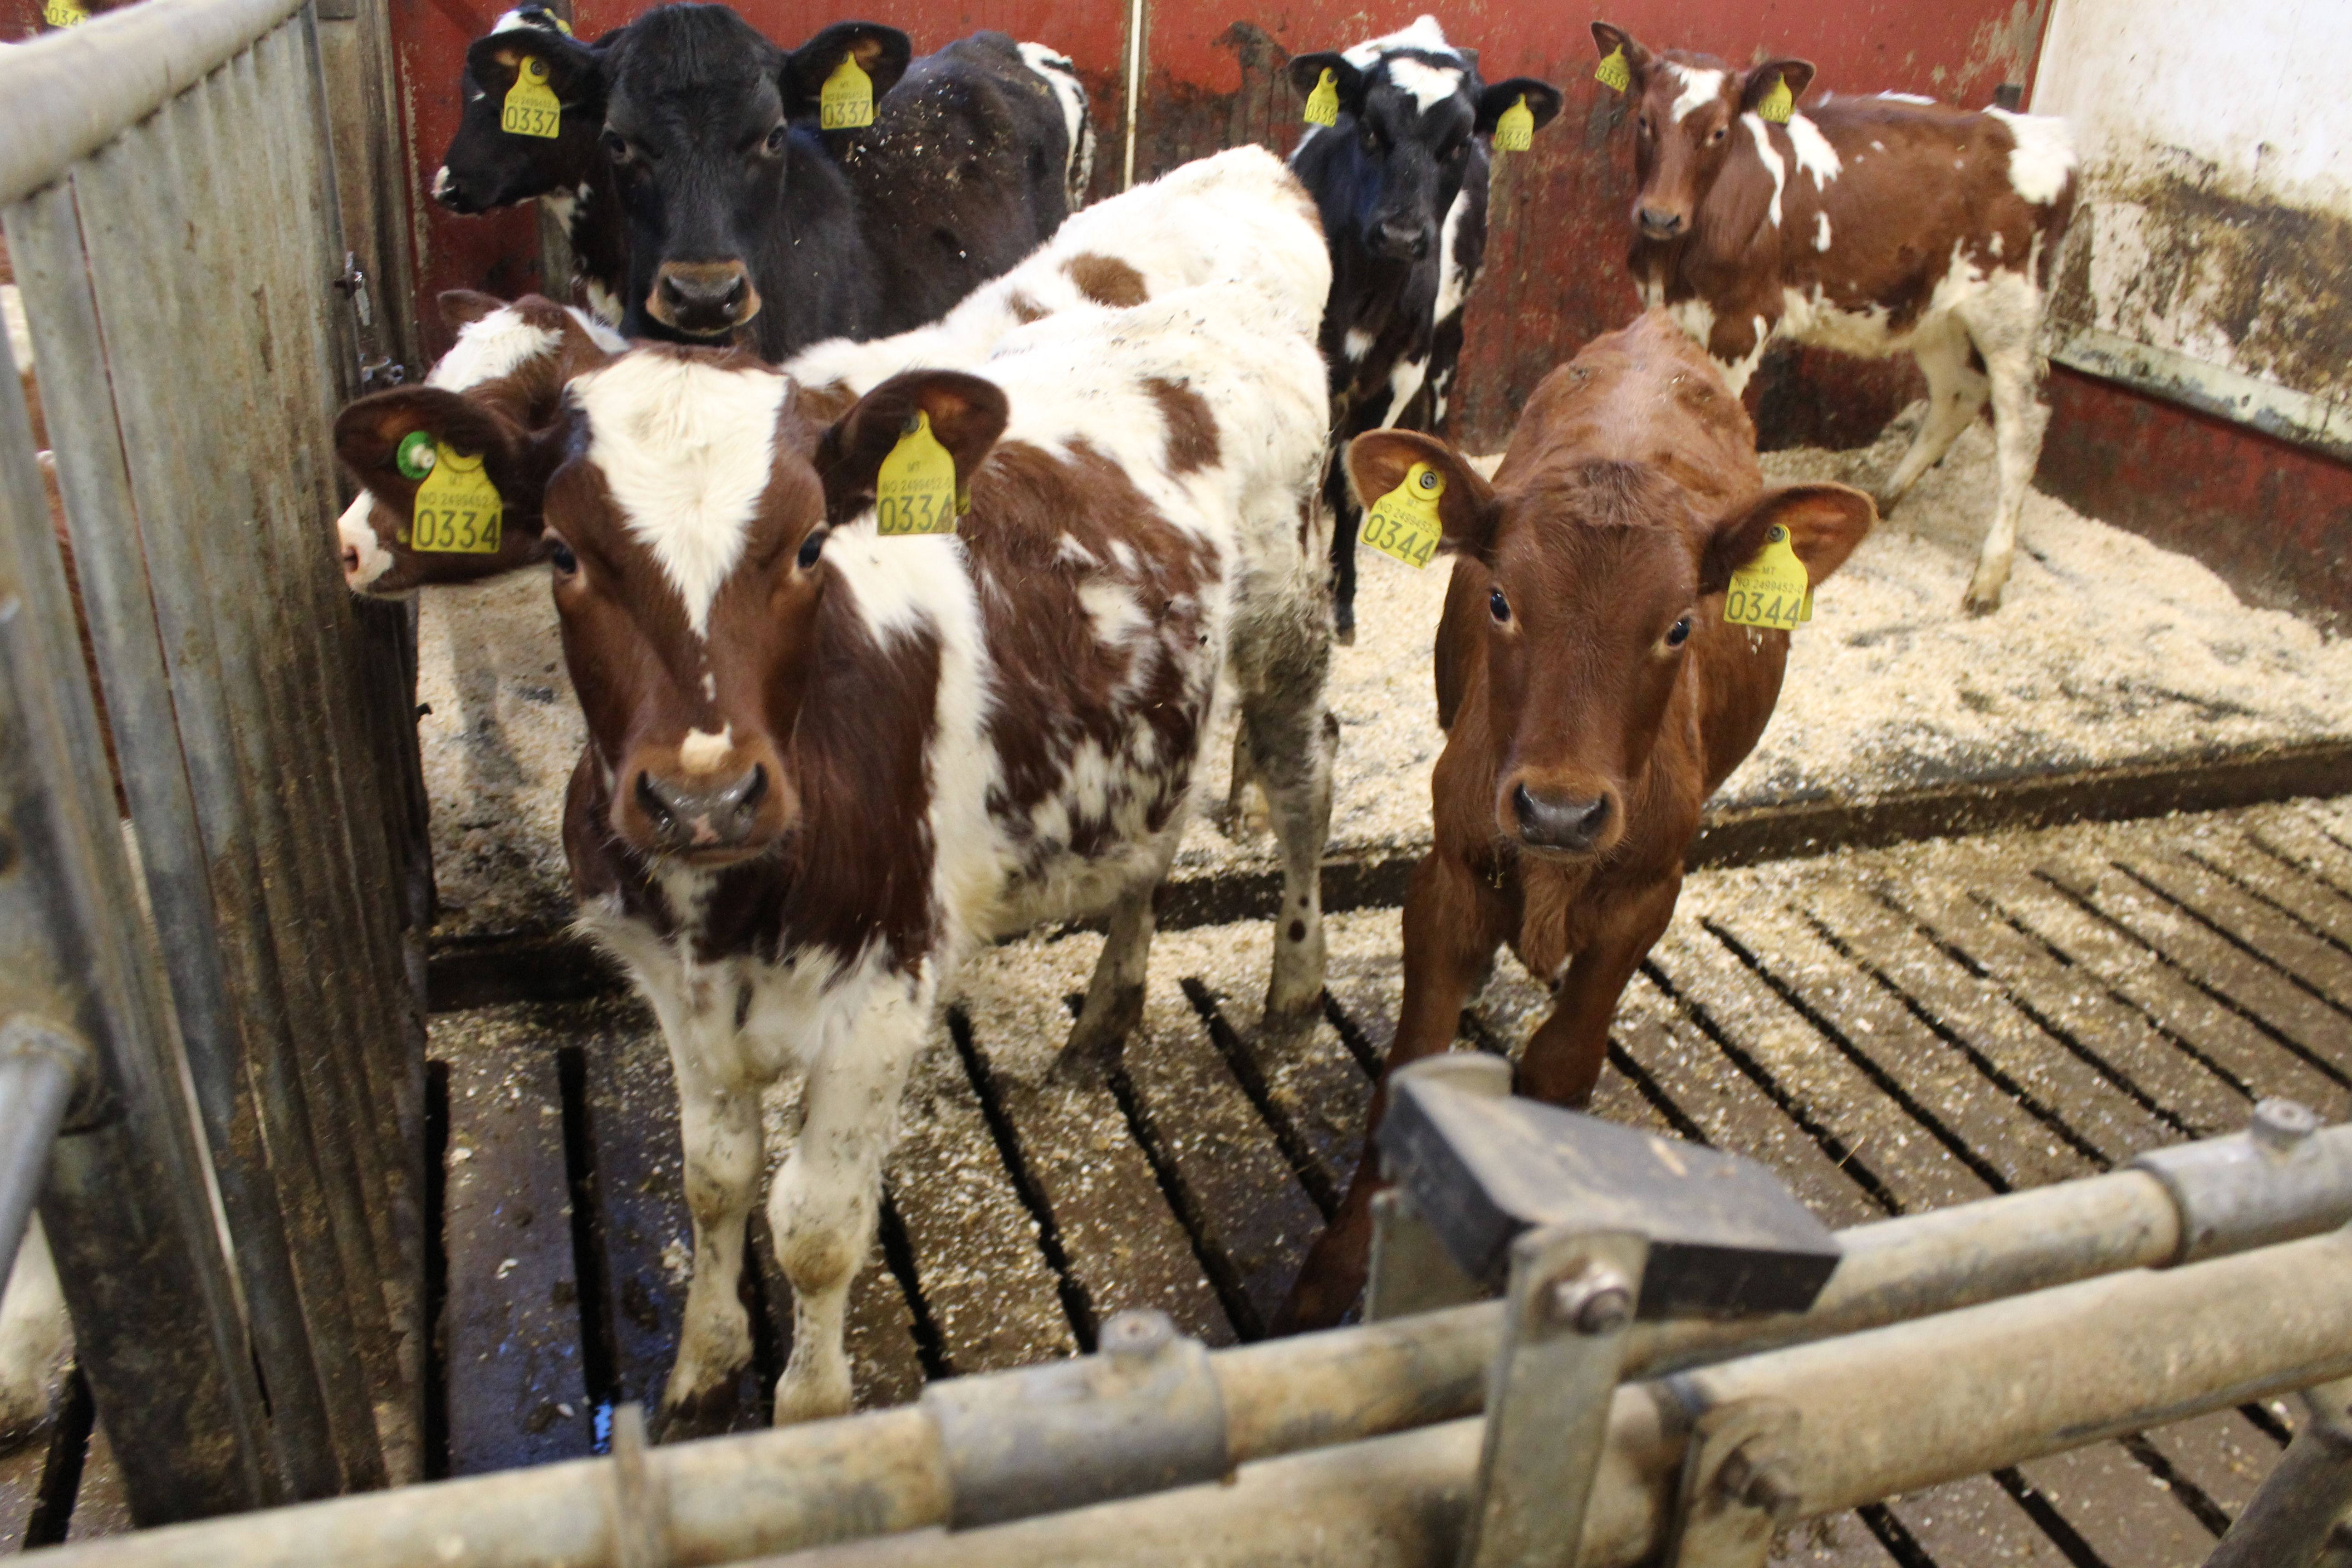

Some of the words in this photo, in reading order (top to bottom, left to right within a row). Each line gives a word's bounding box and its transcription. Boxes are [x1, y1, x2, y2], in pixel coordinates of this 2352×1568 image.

[1597, 65, 1627, 87] 0339
[505, 106, 559, 135] 0337
[823, 100, 870, 126] 0337
[1307, 103, 1336, 123] 0338
[1496, 130, 1530, 147] 0338
[879, 492, 953, 533] 0334
[416, 509, 498, 550] 0334
[1364, 514, 1434, 567] 0344
[1762, 566, 1776, 575] MT
[1727, 590, 1801, 627] 0344
